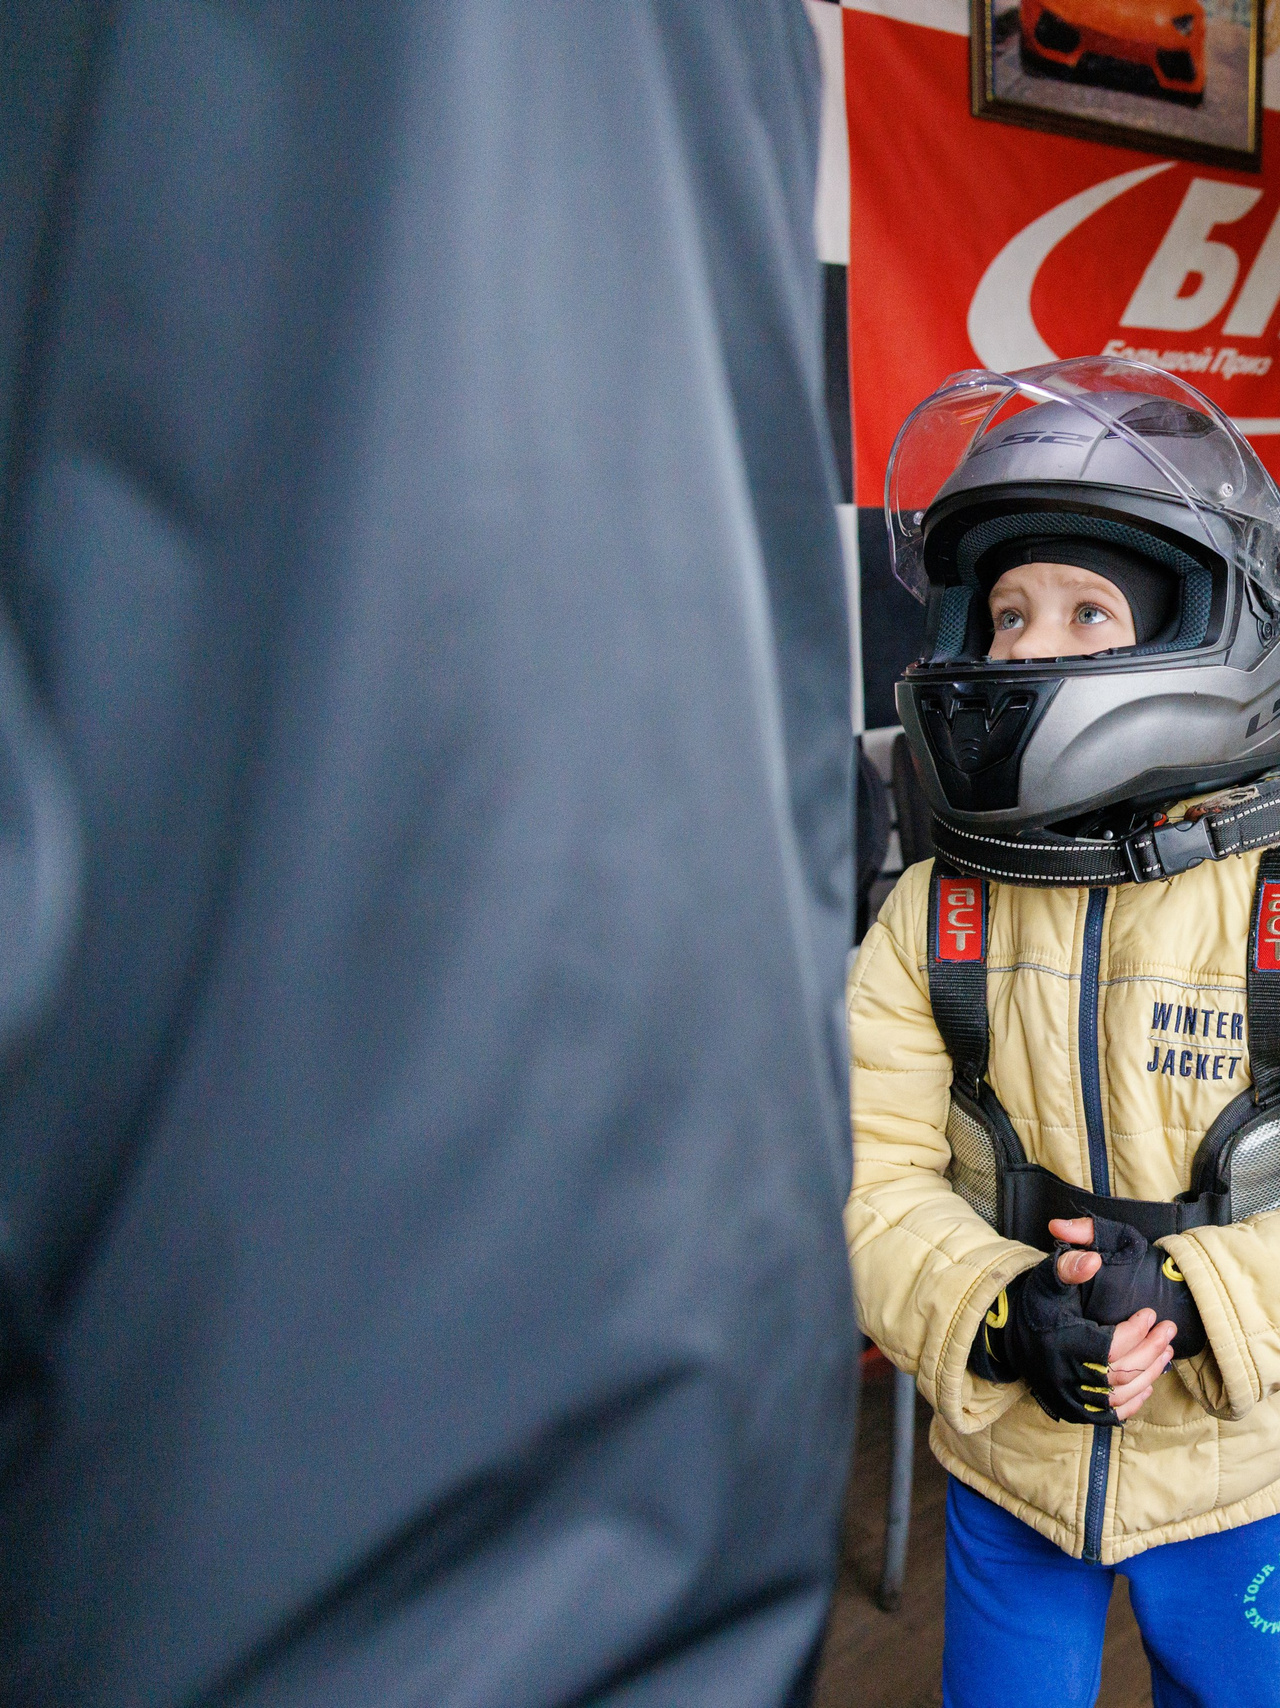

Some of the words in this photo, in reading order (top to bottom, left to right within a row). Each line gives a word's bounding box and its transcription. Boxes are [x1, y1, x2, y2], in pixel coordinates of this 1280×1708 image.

[1152, 1001, 1244, 1040] WINTER
[1147, 1046, 1242, 1080] JACKET
[1243, 1564, 1275, 1604] YOUR
